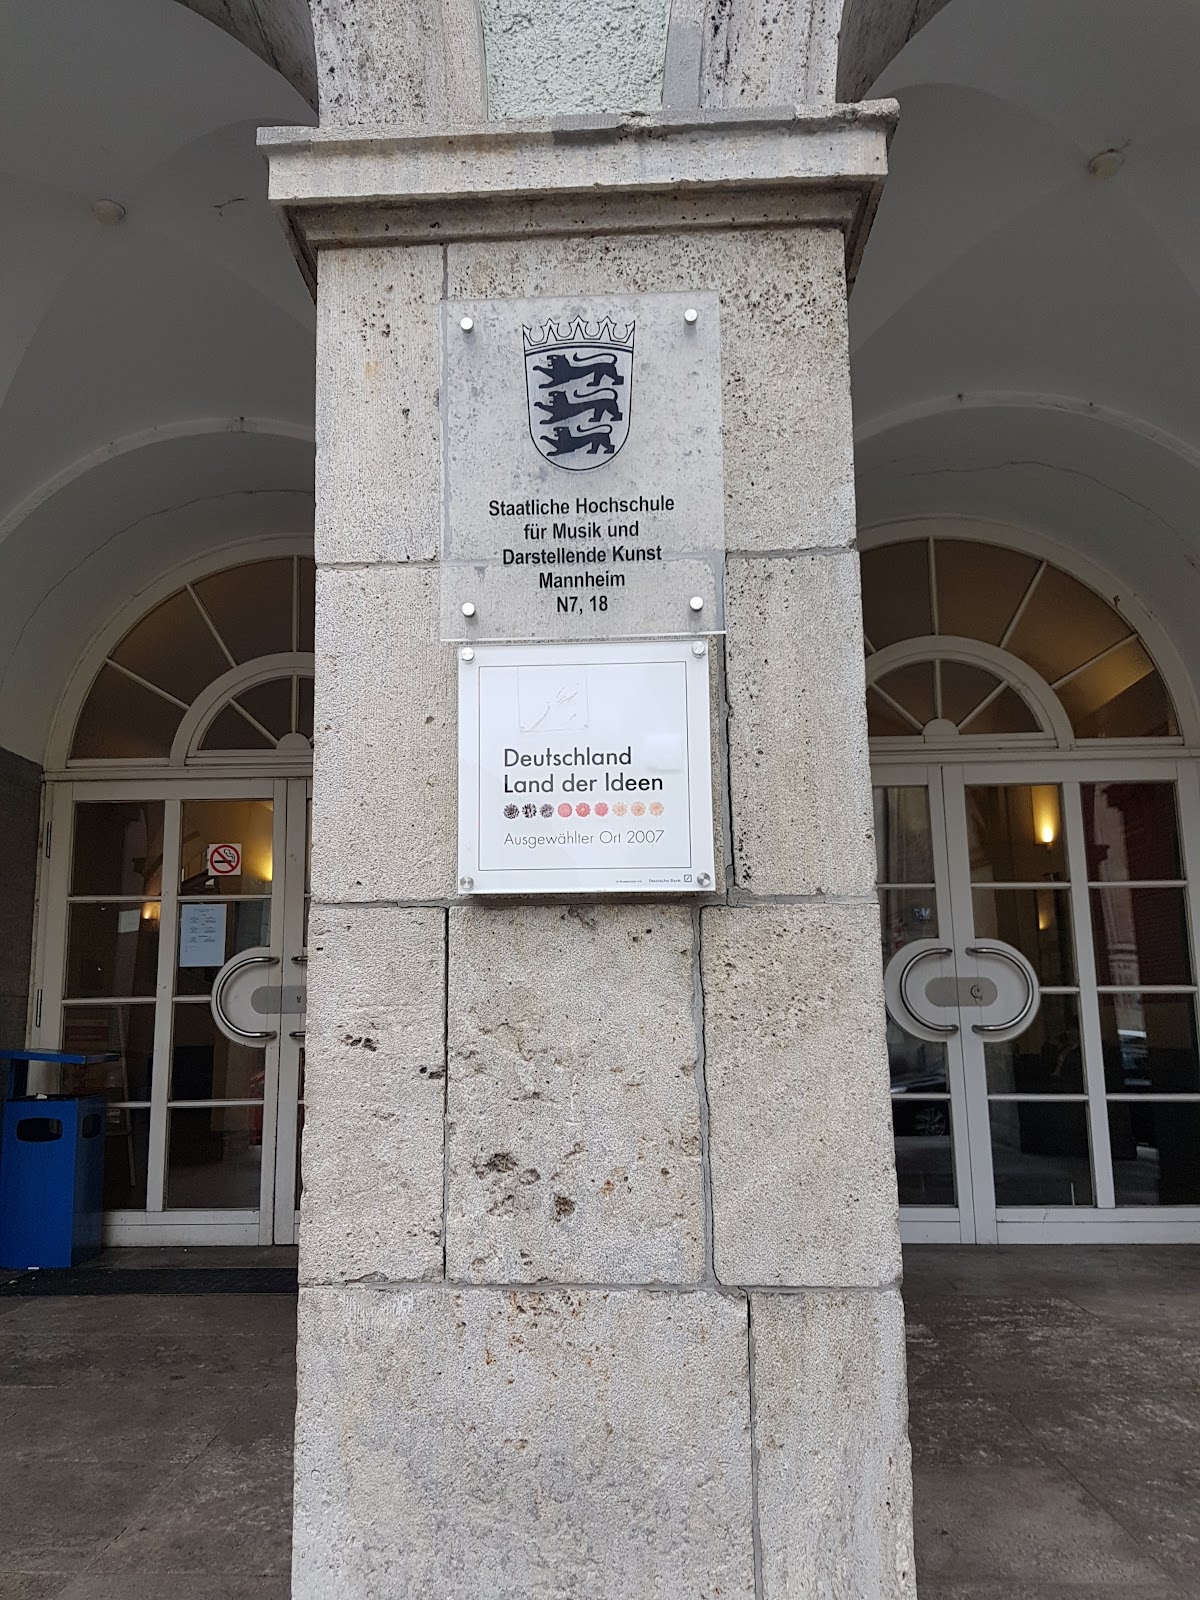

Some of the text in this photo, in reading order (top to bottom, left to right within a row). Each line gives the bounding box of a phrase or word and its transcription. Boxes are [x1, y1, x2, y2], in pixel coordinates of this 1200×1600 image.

[489, 495, 675, 517] Staatliche Hochschule
[524, 521, 639, 540] für Musik und
[502, 545, 663, 565] Darstellende Kunst
[539, 571, 625, 589] Mannheim
[556, 596, 608, 615] N7, 18
[503, 746, 632, 767] Deutschland
[503, 772, 663, 793] Land der Ideen
[503, 829, 665, 848] Ausgewählter Ort 2007
